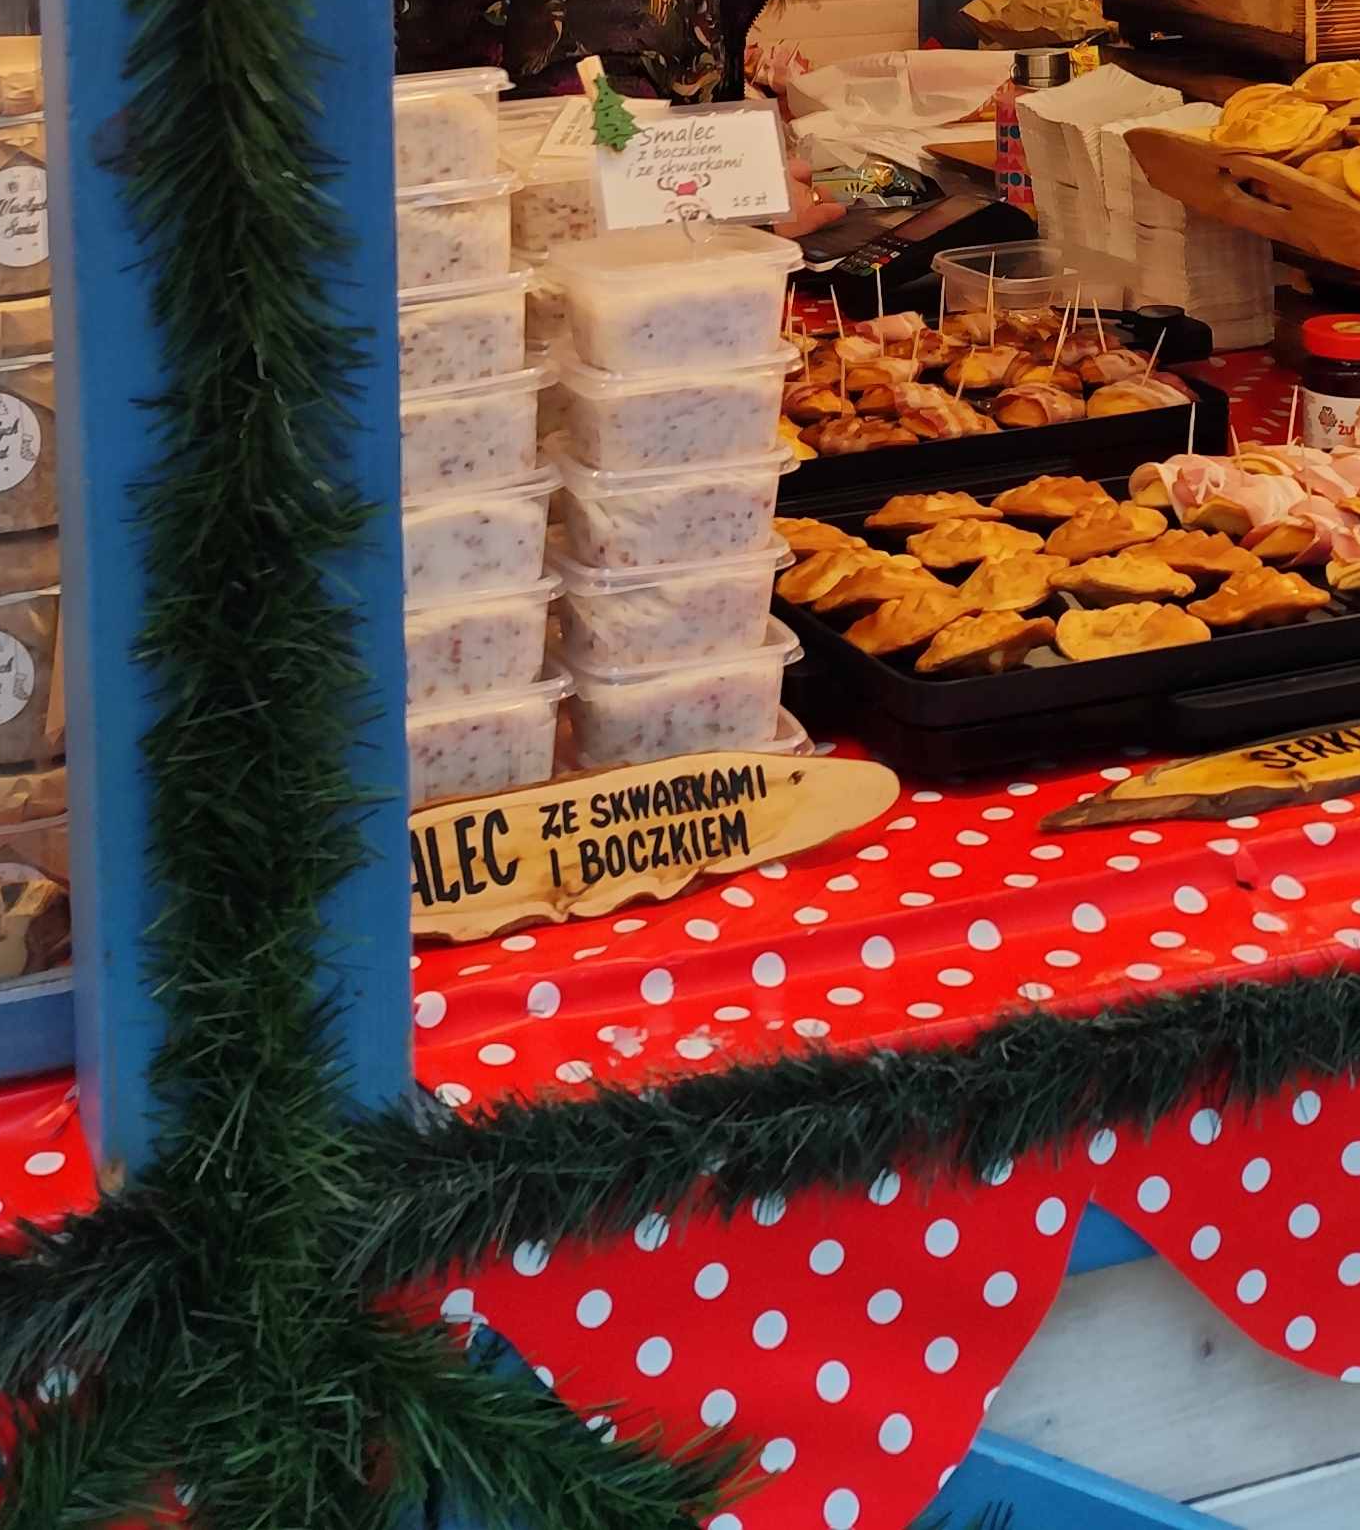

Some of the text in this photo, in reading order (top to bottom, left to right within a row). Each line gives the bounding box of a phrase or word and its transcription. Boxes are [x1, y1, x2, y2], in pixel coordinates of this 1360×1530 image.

[639, 120, 717, 147] Smalec
[637, 141, 723, 161] z boczkiem
[659, 153, 745, 176] skwarkami
[539, 764, 769, 840] ZE SKWARKAMI
[550, 810, 751, 888] I BOCZKIEM
